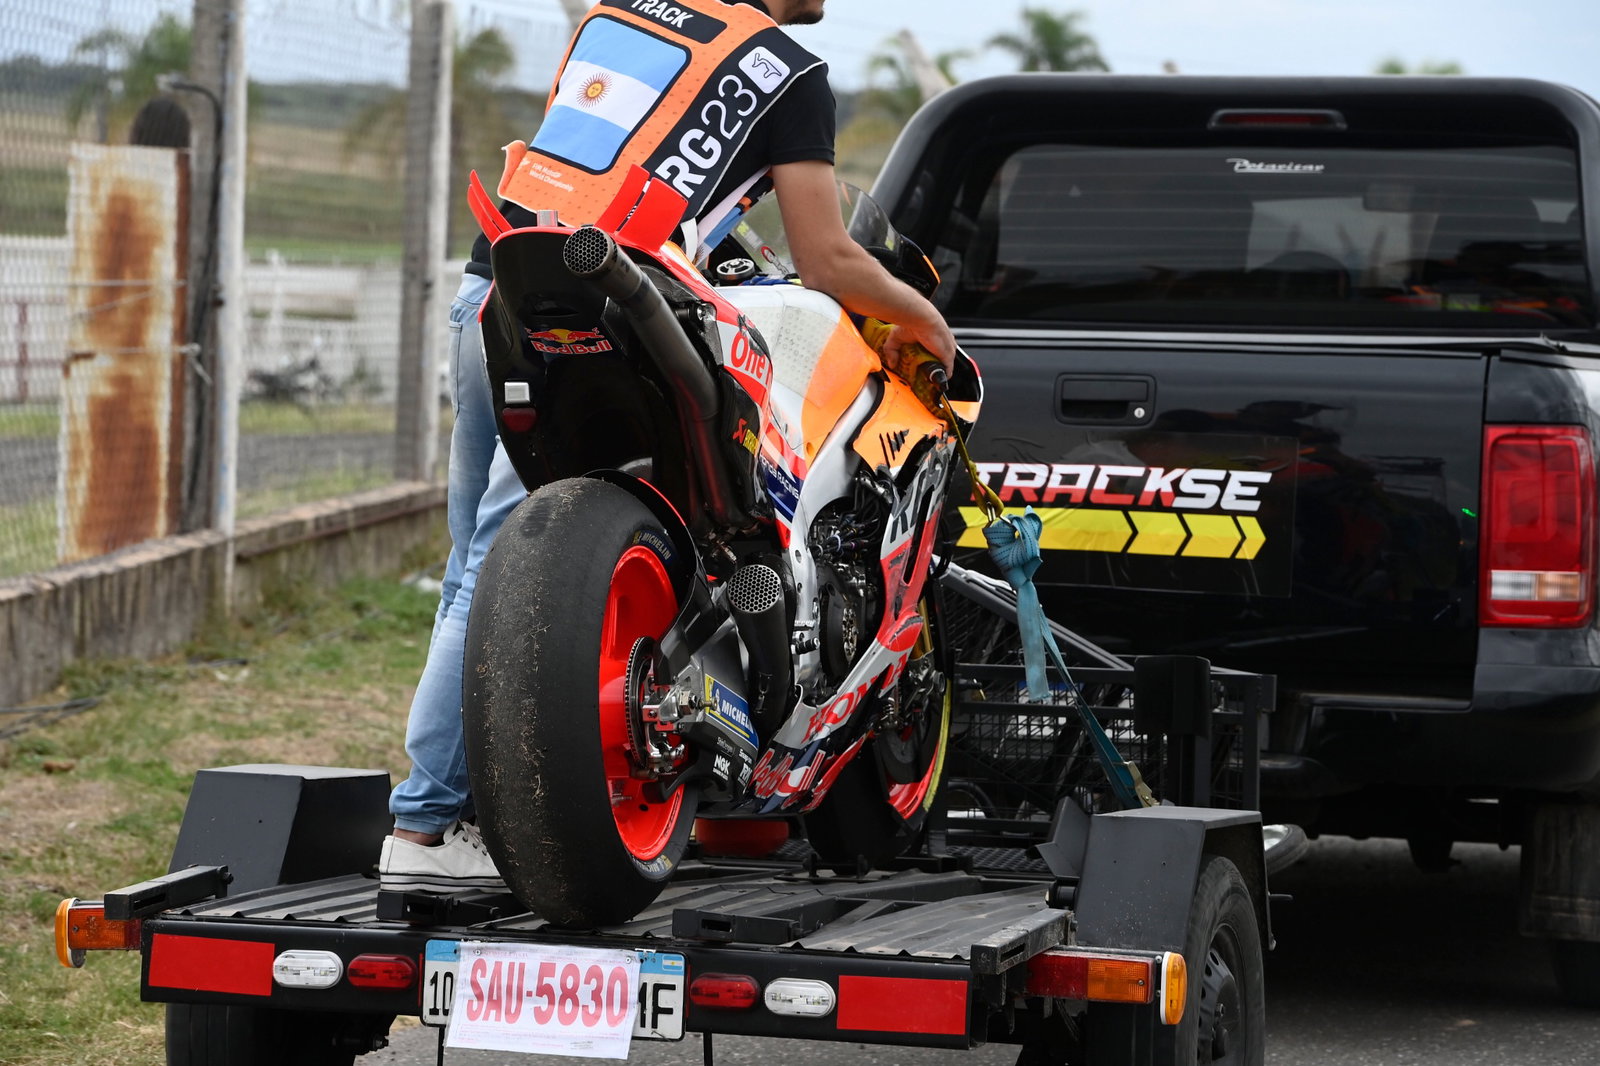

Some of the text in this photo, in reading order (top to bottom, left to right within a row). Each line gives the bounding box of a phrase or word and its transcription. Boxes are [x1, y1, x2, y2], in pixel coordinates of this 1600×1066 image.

[655, 74, 758, 199] RG23
[530, 339, 613, 355] Red Bull
[731, 331, 767, 380] One
[641, 532, 672, 560] MICHELIN
[714, 754, 731, 775] NGK
[466, 958, 629, 1028] SAU-5830
